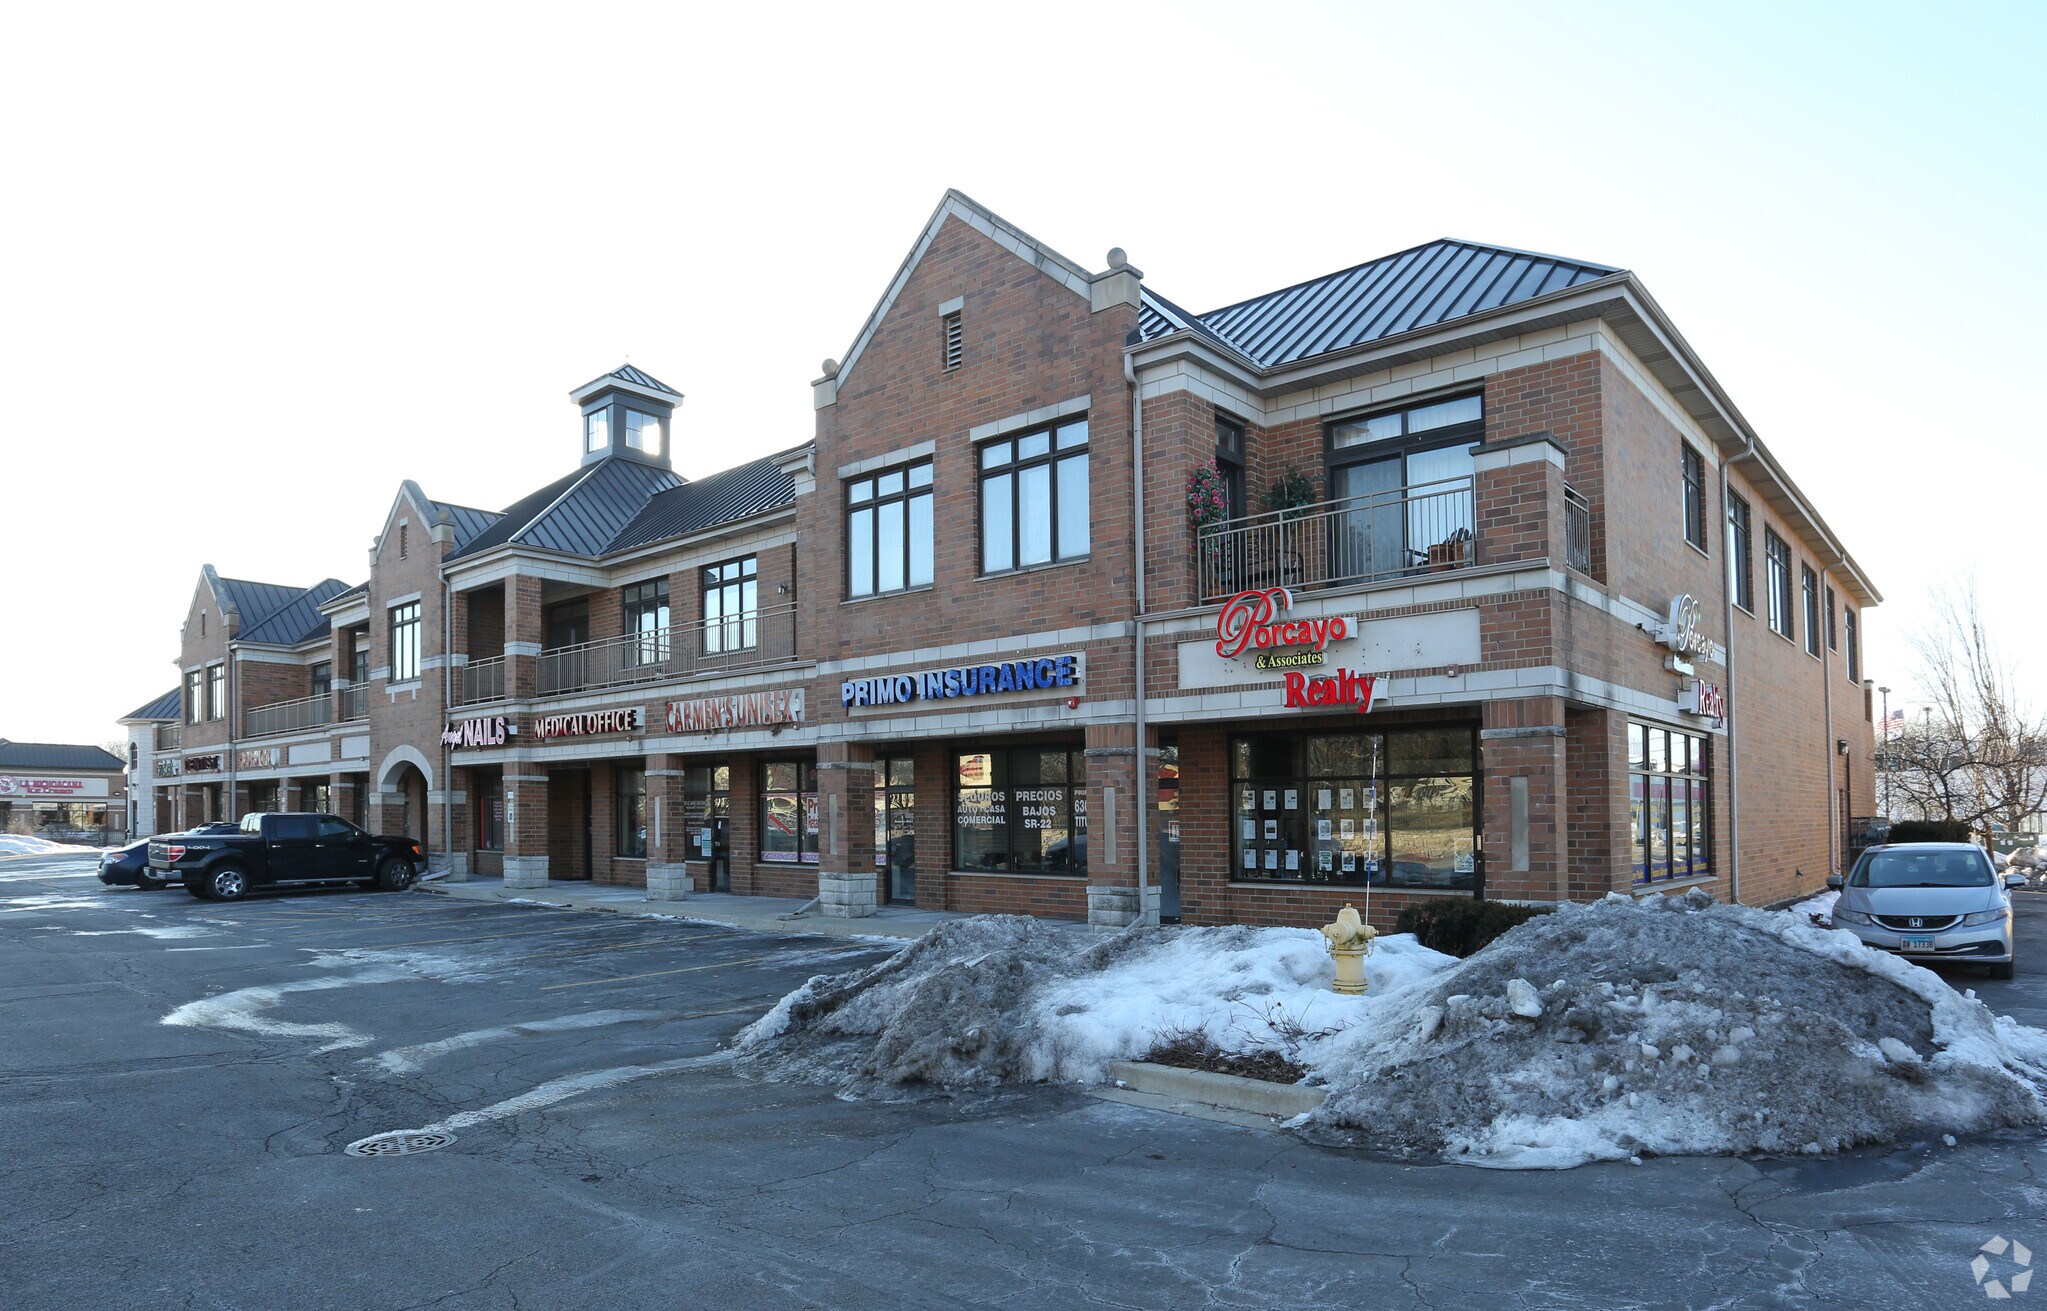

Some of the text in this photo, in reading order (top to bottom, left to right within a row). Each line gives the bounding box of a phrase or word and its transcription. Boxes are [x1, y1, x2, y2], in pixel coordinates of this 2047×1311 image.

[1216, 587, 1348, 659] Porcayo
[1255, 651, 1323, 669] & Associates
[841, 655, 1075, 708] PRIMO INSURANCE
[1283, 667, 1376, 714] Realty
[665, 689, 794, 734] CARMEN'S UNISEX
[1698, 679, 1724, 728] Realty
[464, 716, 507, 747] NAILS
[534, 709, 635, 739] MEDICAL OFFICE
[957, 791, 1006, 802] SEGUROS
[1015, 790, 1063, 802] PRECIOS
[957, 804, 1006, 813] AUTO CASA
[957, 815, 1006, 825] COMERCIAL
[1022, 806, 1057, 816] BAJOS
[1024, 818, 1052, 829] SR-22
